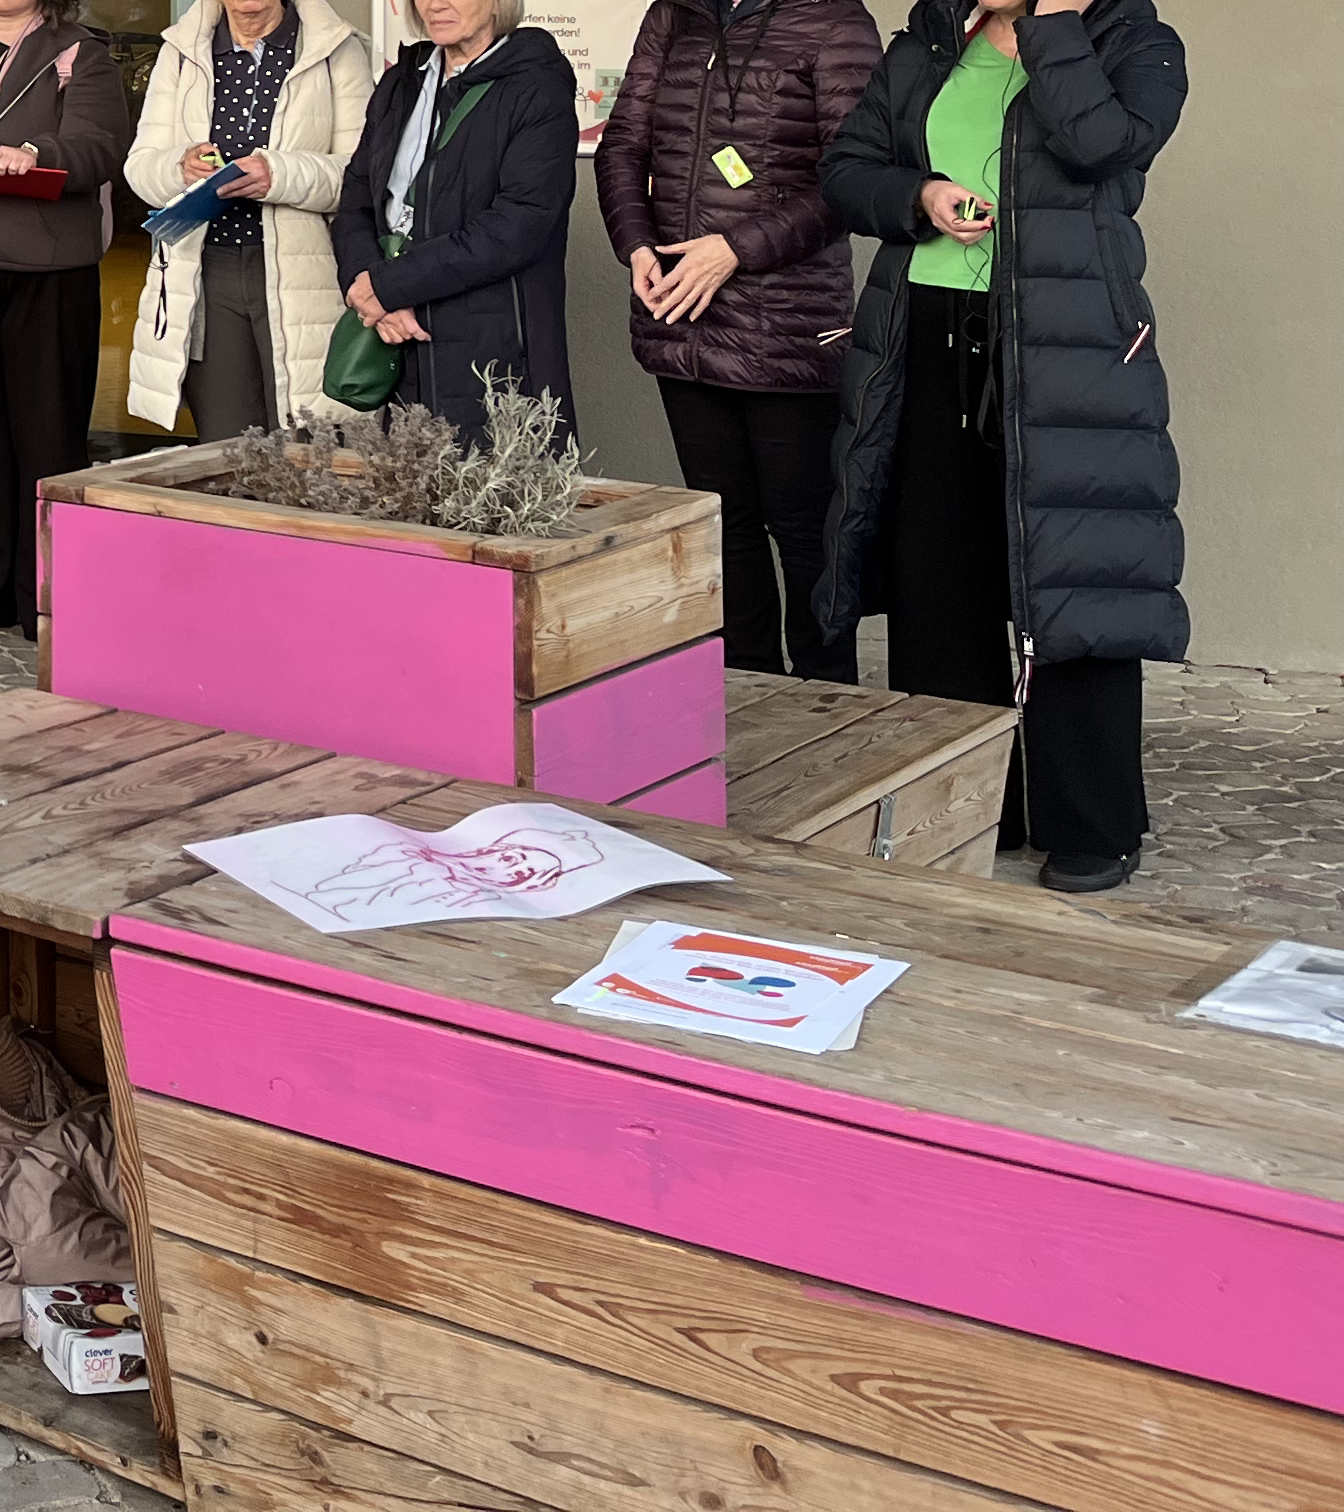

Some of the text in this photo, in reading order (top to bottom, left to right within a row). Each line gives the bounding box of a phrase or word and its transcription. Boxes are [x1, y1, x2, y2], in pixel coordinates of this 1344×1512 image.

[547, 14, 577, 24] keine
[567, 47, 589, 57] und
[84, 1348, 114, 1358] clever
[84, 1357, 116, 1372] SOFT
[86, 1371, 112, 1382] CAKE
